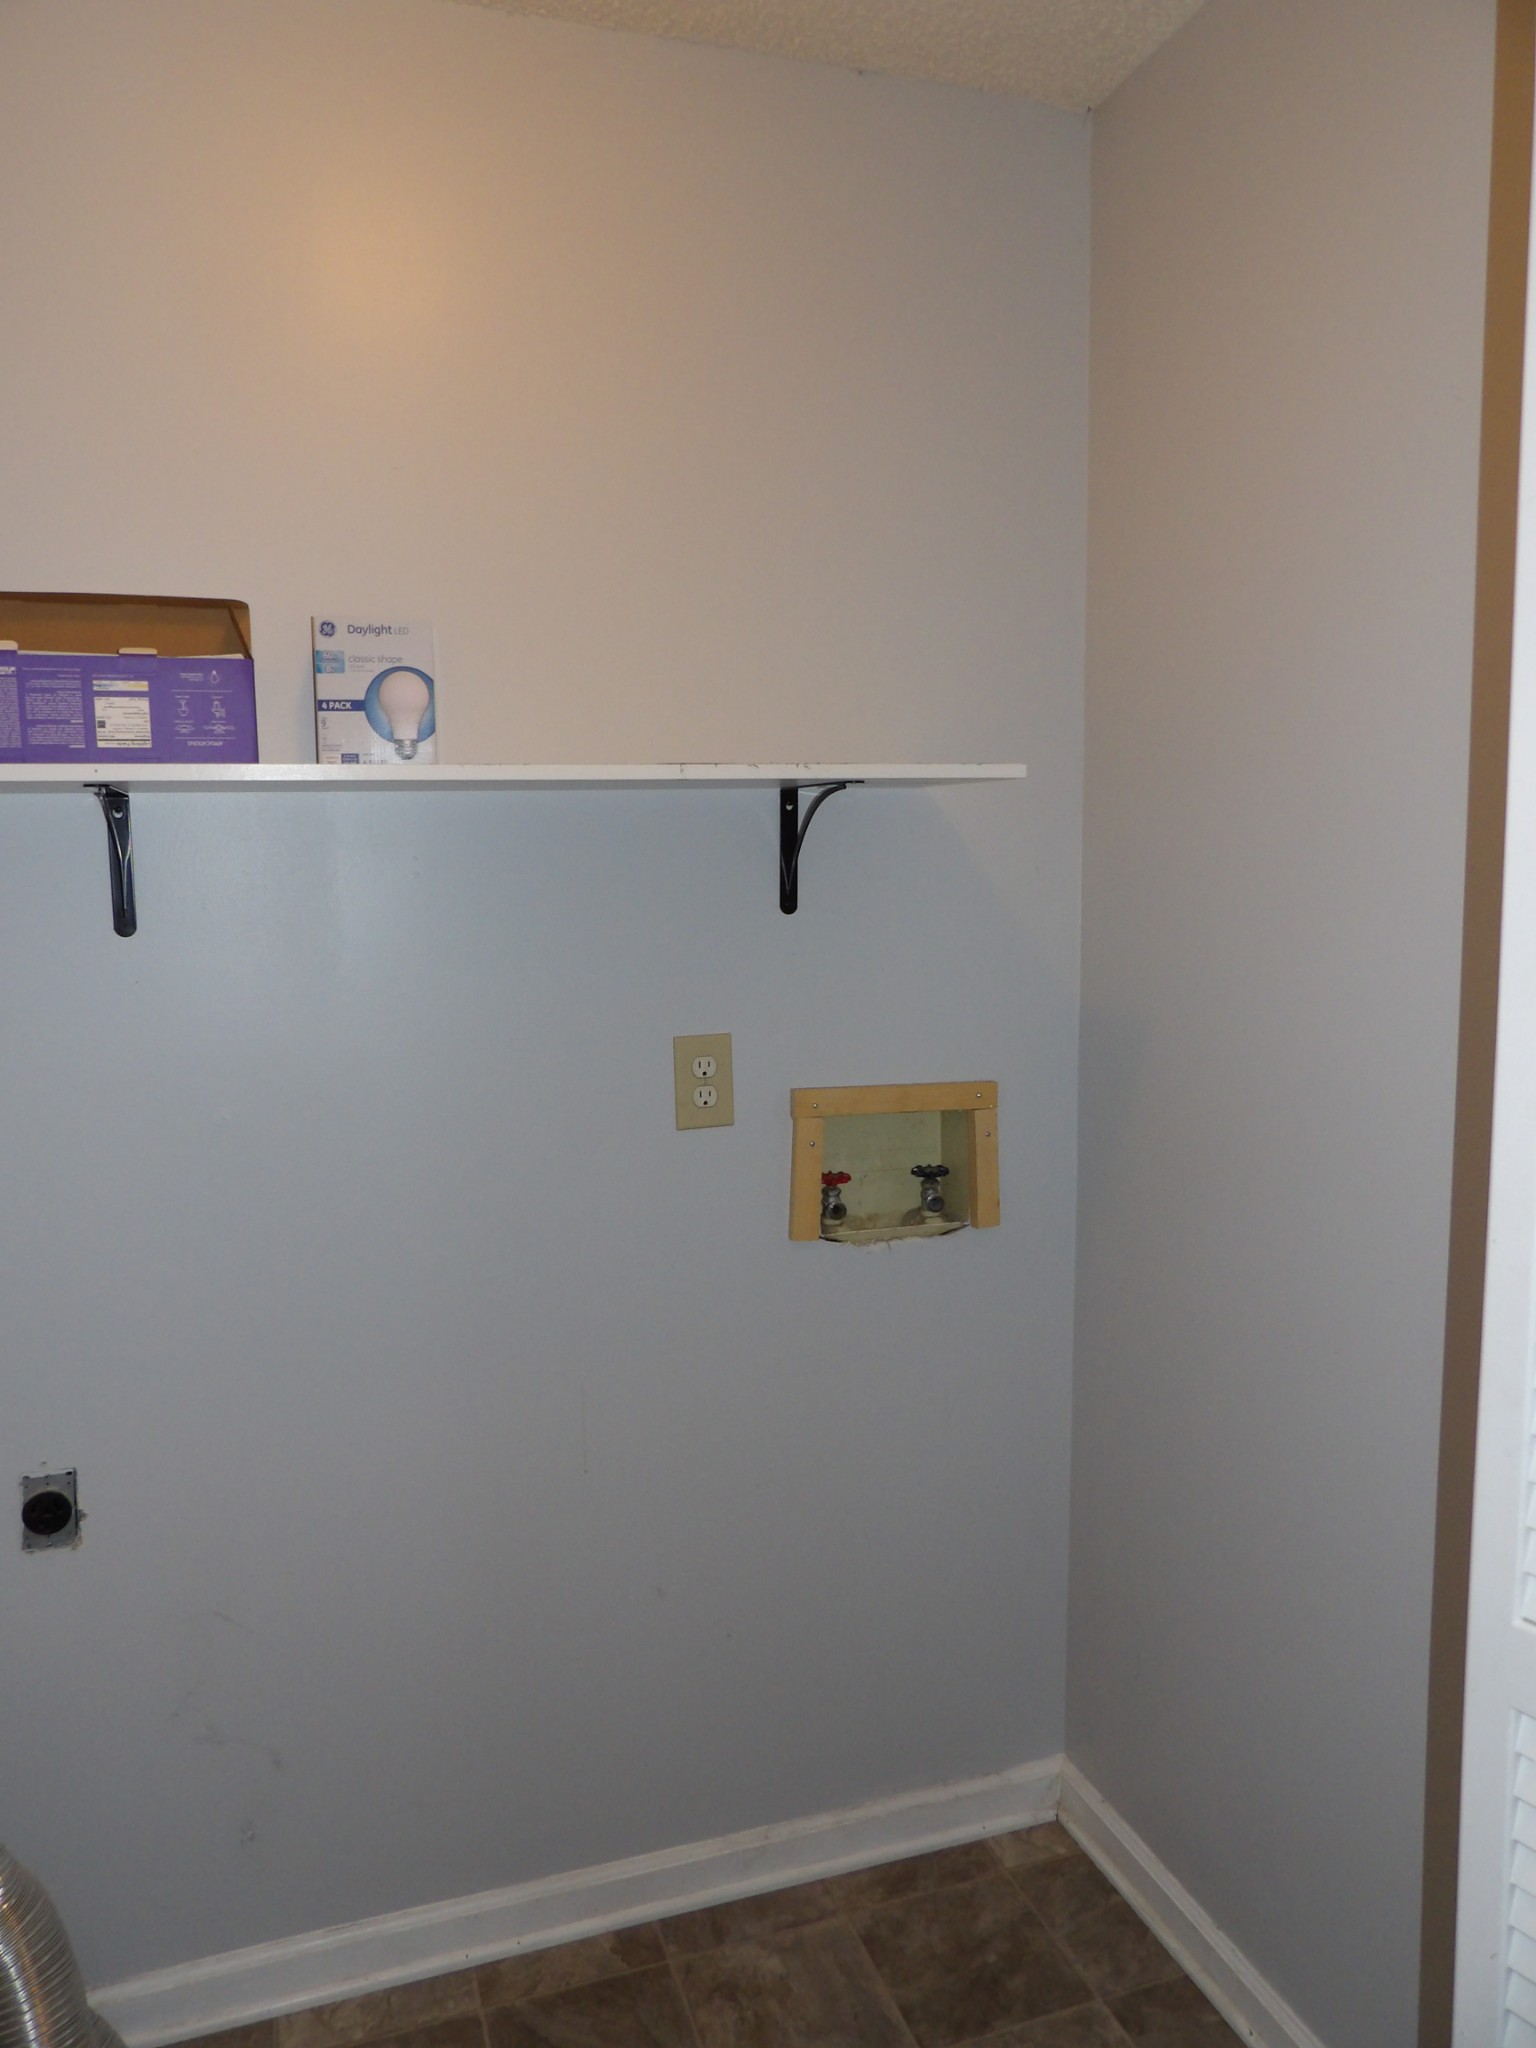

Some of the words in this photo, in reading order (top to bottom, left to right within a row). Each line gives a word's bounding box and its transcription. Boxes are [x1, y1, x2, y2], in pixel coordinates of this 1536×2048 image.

[347, 624, 392, 636] Daylight
[394, 627, 409, 635] LED
[348, 654, 375, 663] classic
[378, 655, 403, 664] shape
